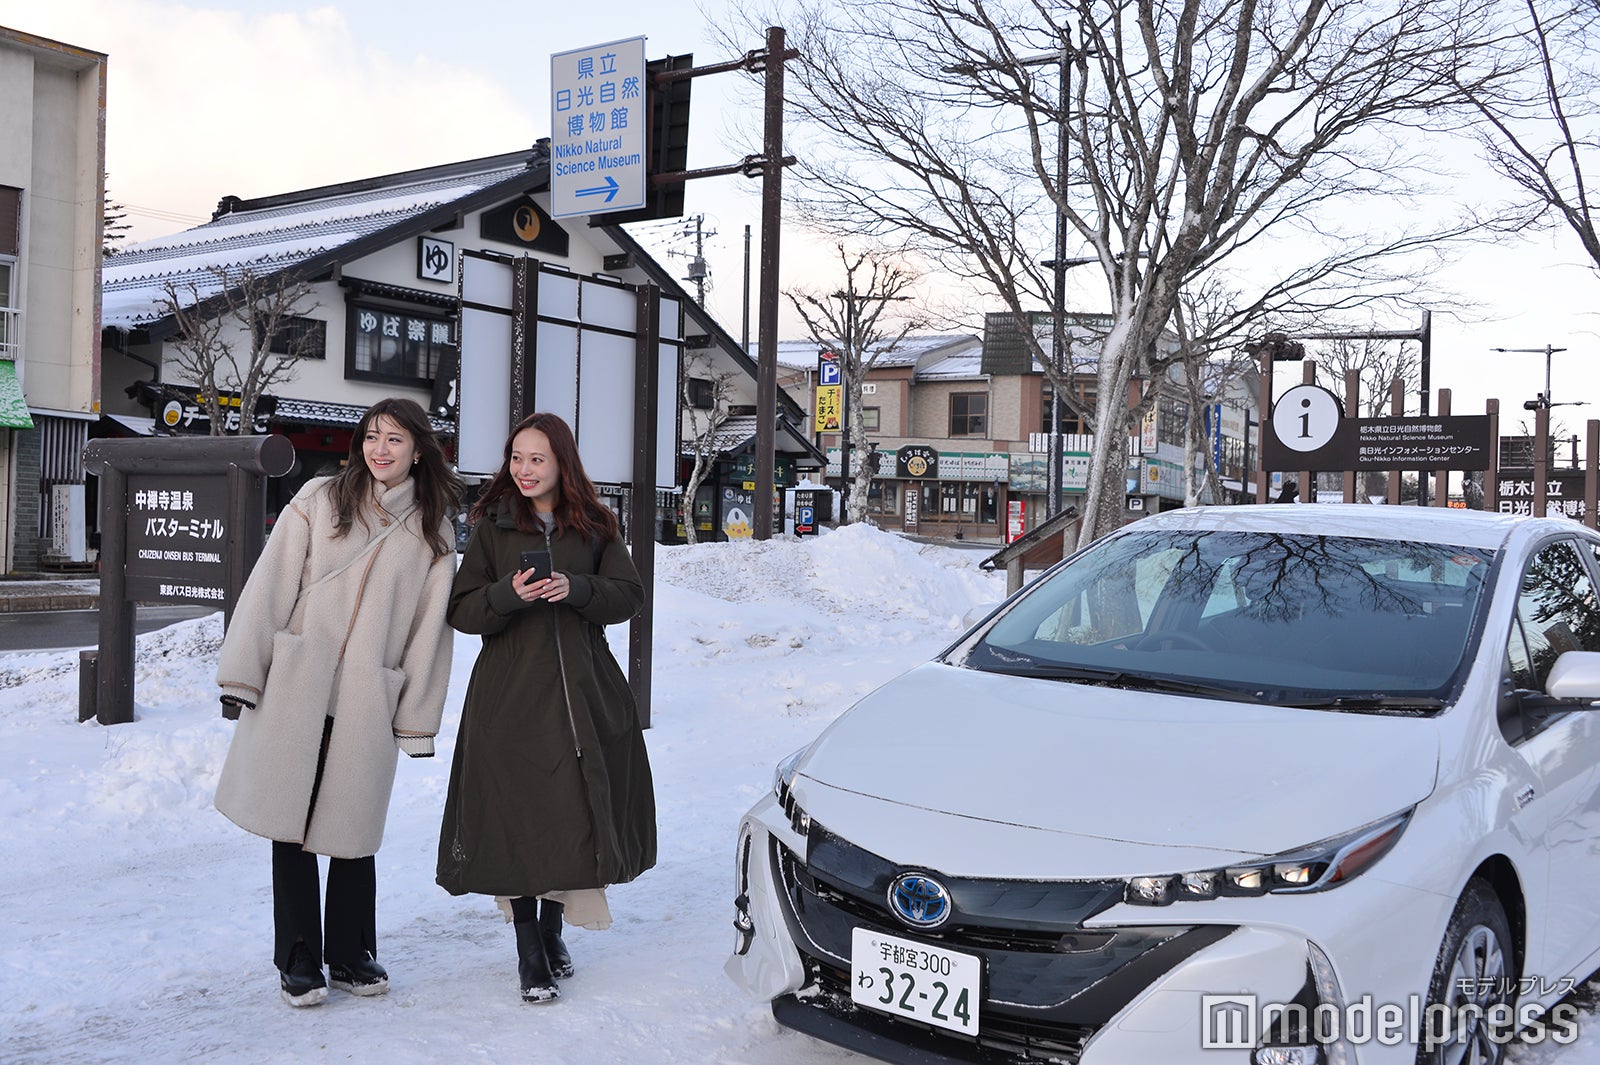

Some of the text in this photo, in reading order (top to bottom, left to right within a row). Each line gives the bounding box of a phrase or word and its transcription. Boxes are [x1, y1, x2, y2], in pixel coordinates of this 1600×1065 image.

[577, 53, 617, 80] 県立
[556, 77, 640, 111] 日光自然
[567, 107, 629, 137] 博物館
[555, 135, 622, 159] Nikko Natural
[555, 152, 641, 177] Science Museum
[425, 244, 449, 275] ゆ
[817, 396, 827, 425] たまご
[827, 388, 836, 415] チーズ
[1359, 424, 1443, 434] 栃木県立日光自然博物館
[1359, 445, 1480, 455] 奥日光インフォメーションセンター
[135, 489, 194, 511] 中禅寺温泉
[144, 517, 224, 539] バスターミナル
[801, 509, 812, 523] P
[138, 549, 221, 563] CHUZENJI ONSEN BUS TERMINAL
[159, 584, 225, 600] 東武バス日光株式会社
[858, 966, 971, 1027] わ 32-24
